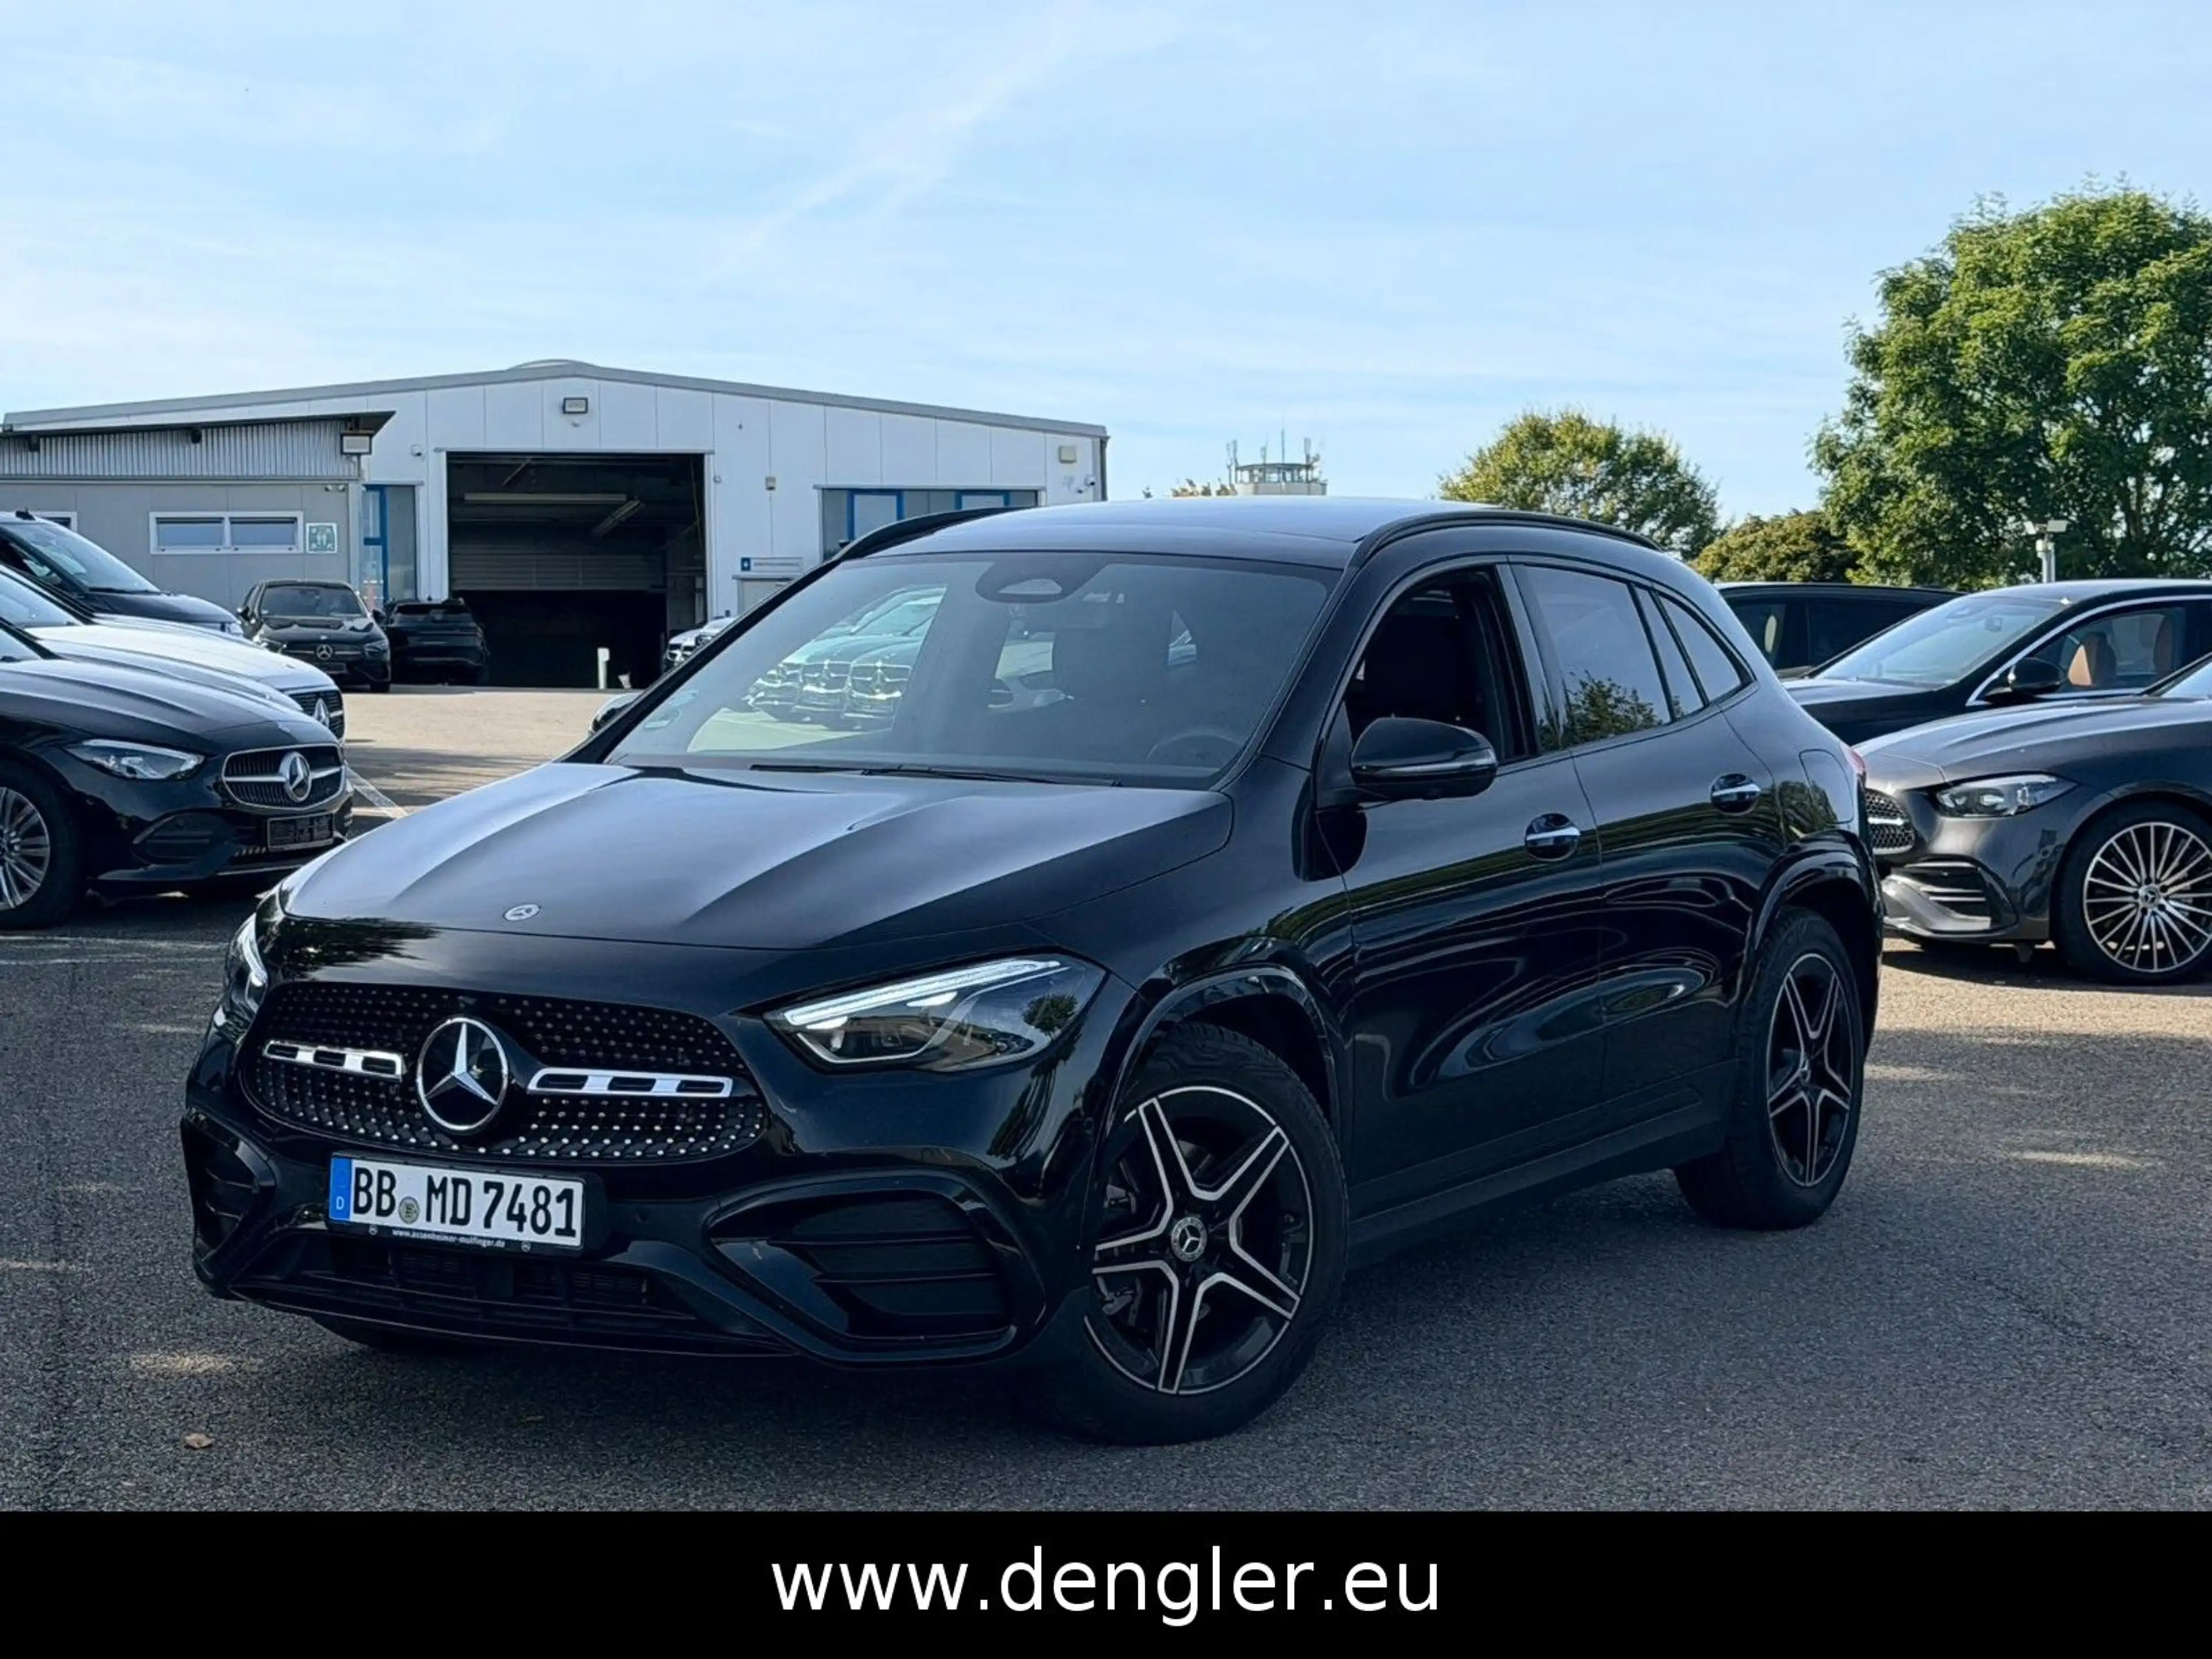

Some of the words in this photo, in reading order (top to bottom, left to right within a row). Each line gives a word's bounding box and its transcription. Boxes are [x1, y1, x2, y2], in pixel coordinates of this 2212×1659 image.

[336, 1196, 345, 1210] D
[354, 1167, 396, 1217] BB
[426, 1175, 472, 1226] MD
[484, 1180, 576, 1238] 7481
